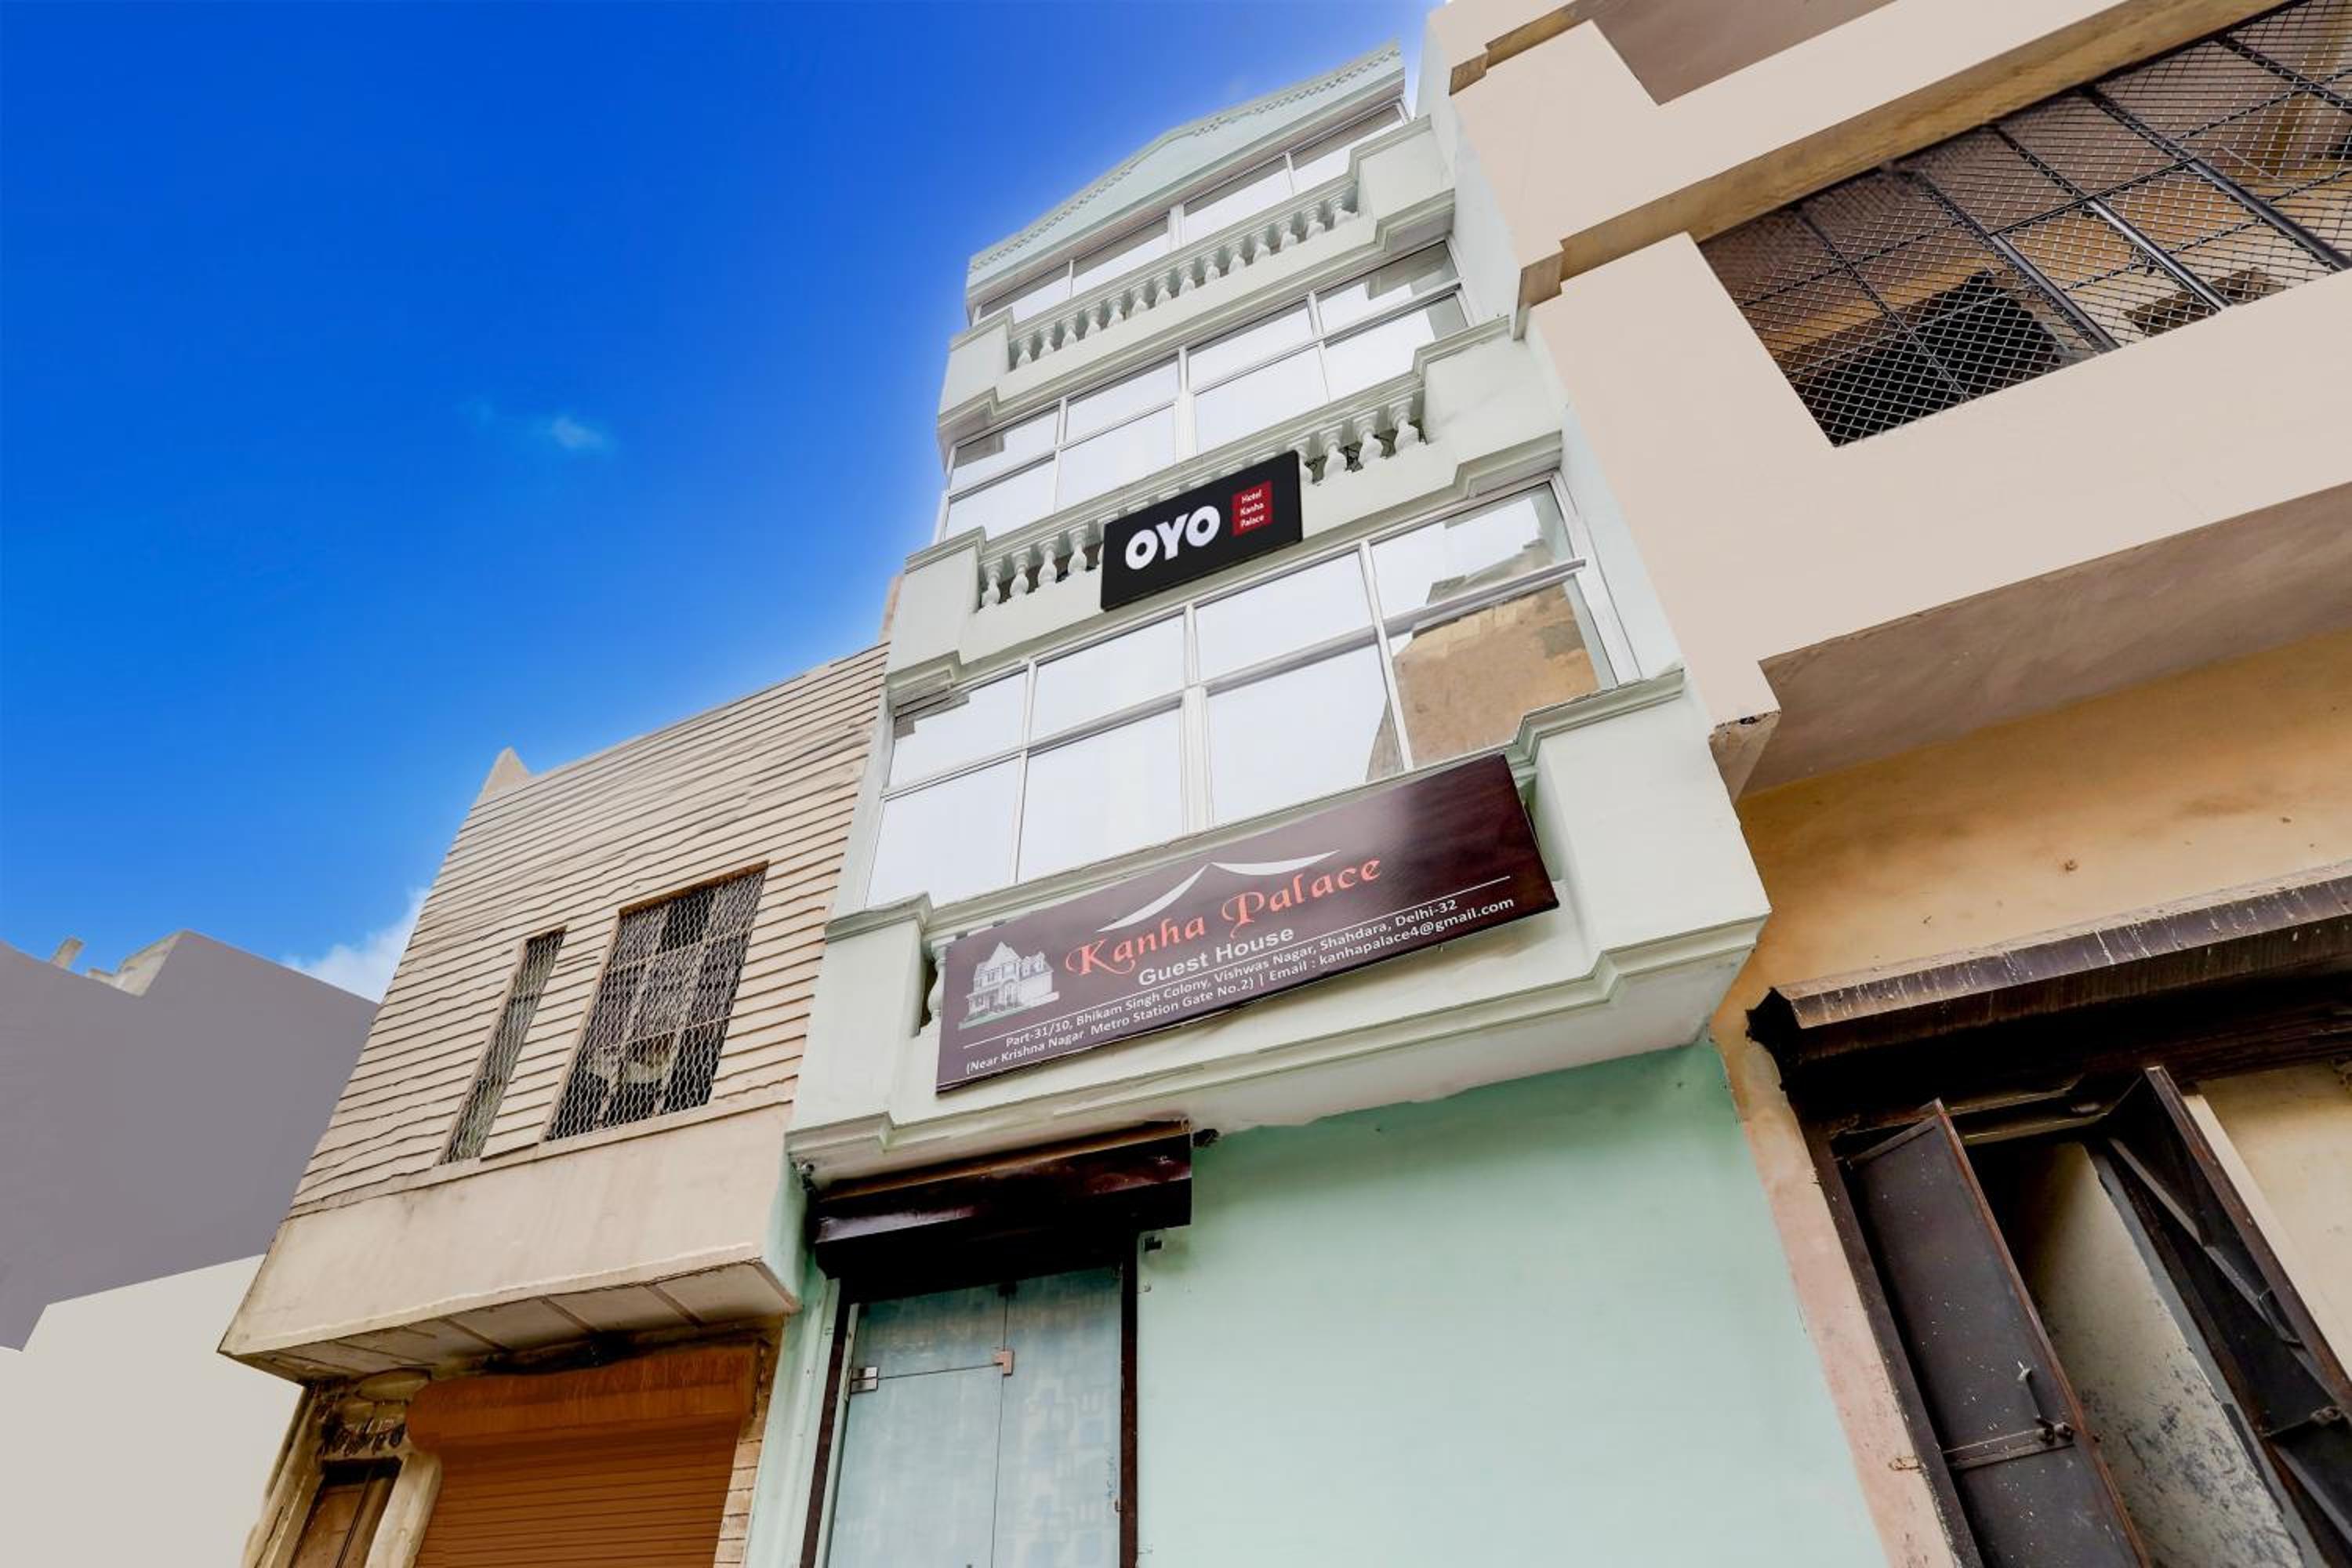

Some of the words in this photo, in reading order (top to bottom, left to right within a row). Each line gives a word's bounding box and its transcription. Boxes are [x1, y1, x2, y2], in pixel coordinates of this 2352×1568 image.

[1125, 506, 1221, 570] OYO
[1241, 488, 1261, 504] Hotel
[1065, 916, 1206, 976] Kanha
[1221, 856, 1381, 939] Palace
[1138, 953, 1209, 985] Guest
[1216, 928, 1294, 964] House
[966, 1057, 1001, 1075] (Near
[1001, 1044, 1045, 1062] Krishna
[1091, 1016, 1130, 1036] Metro
[1133, 1002, 1178, 1023] Station
[1182, 991, 1214, 1007] Gate
[1218, 976, 1254, 997] No.2)
[1269, 960, 1307, 981] Email
[1319, 898, 1515, 965] kanhapalace4@gmail.com
[1006, 1020, 1073, 1047] Part-31/10,
[1076, 1005, 1123, 1026] Bhikam
[1126, 990, 1160, 1011] Singh
[1163, 978, 1210, 999] Colony,
[1214, 960, 1269, 982] Vishwas
[1272, 946, 1316, 965] Nagar,
[1319, 921, 1392, 951] Shahdara,
[1395, 899, 1457, 927] Delhi-32
